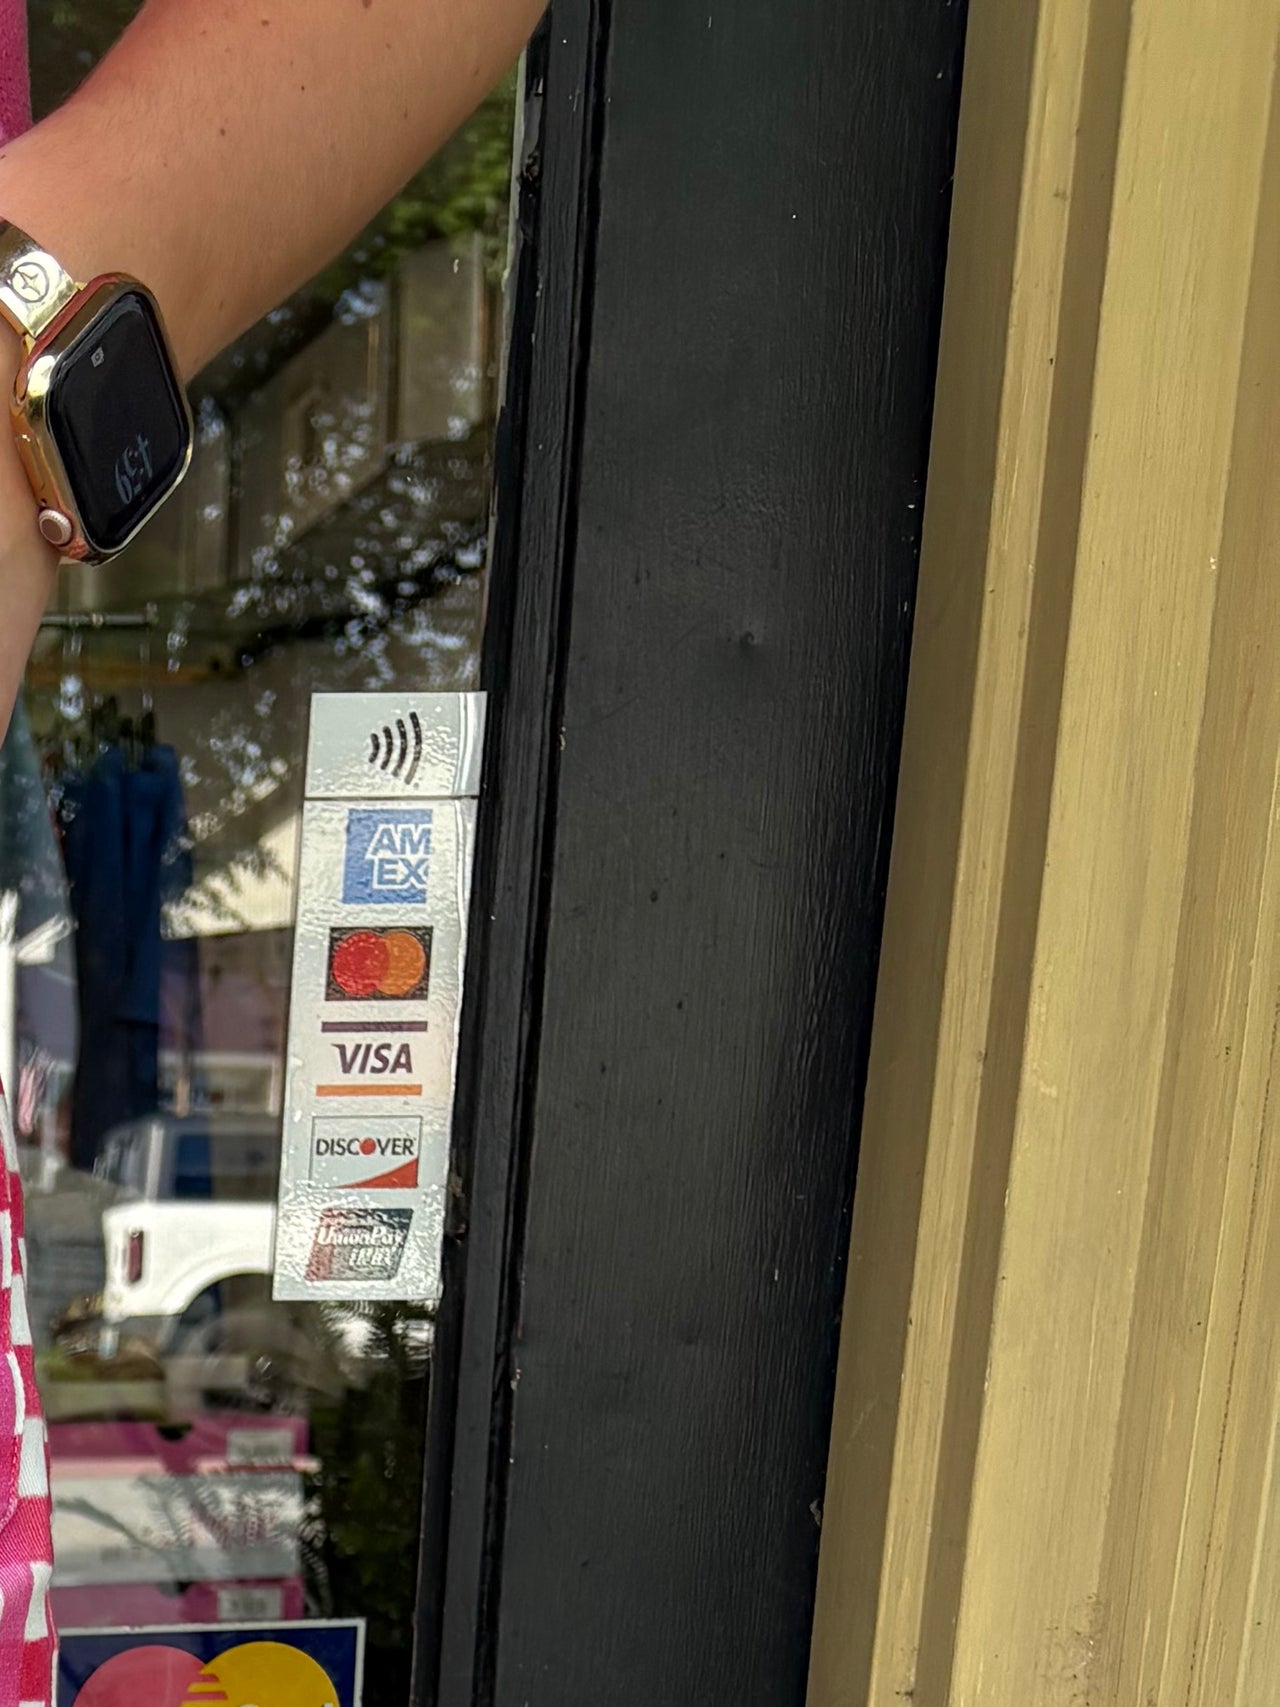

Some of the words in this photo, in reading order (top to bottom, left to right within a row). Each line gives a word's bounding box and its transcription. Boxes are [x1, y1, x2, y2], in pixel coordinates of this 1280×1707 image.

[366, 824, 432, 859] AM
[373, 857, 428, 889] EX
[331, 1043, 413, 1075] VISA
[316, 1137, 416, 1157] DISCOVER
